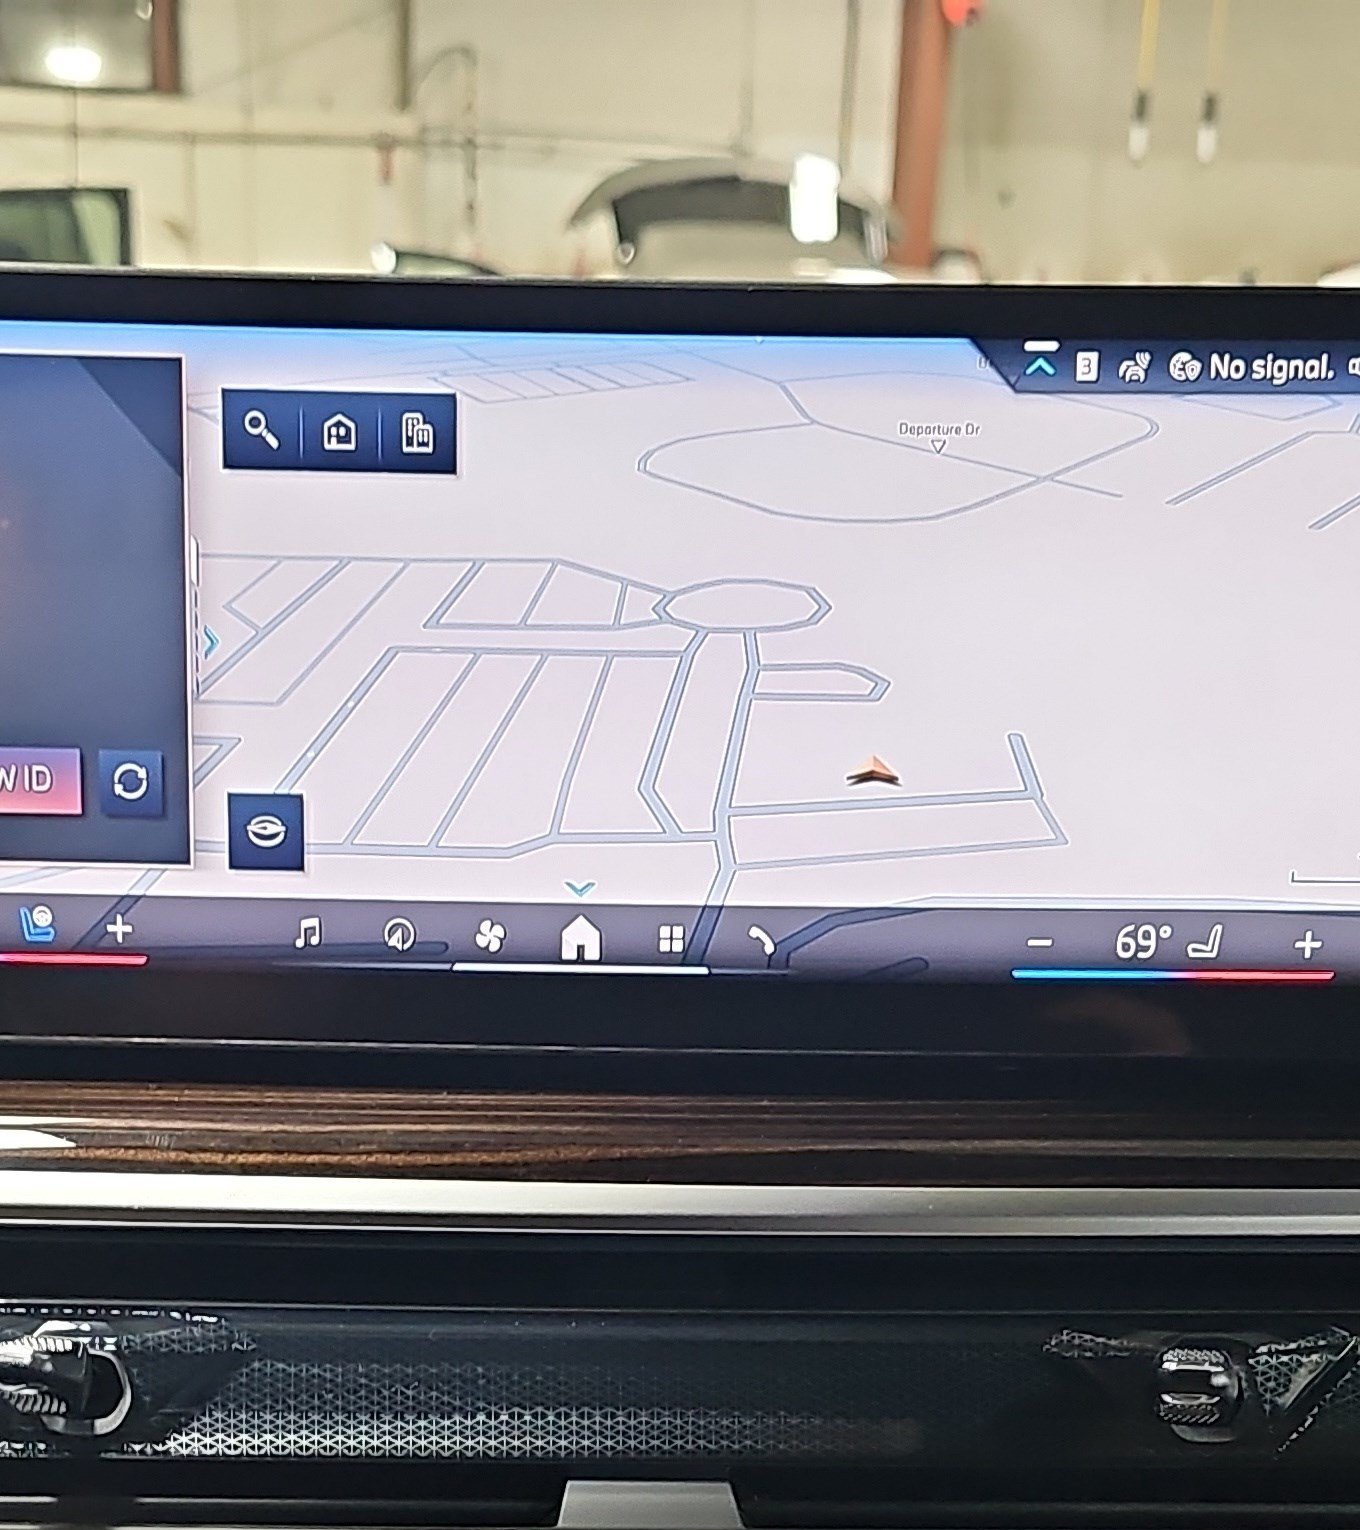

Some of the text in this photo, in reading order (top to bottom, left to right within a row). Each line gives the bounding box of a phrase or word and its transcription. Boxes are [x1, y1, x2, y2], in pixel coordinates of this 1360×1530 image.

[1210, 354, 1334, 384] No signal.
[899, 422, 980, 436] Departure Dr
[24, 766, 52, 793] ID
[1115, 924, 1173, 960] 69°
